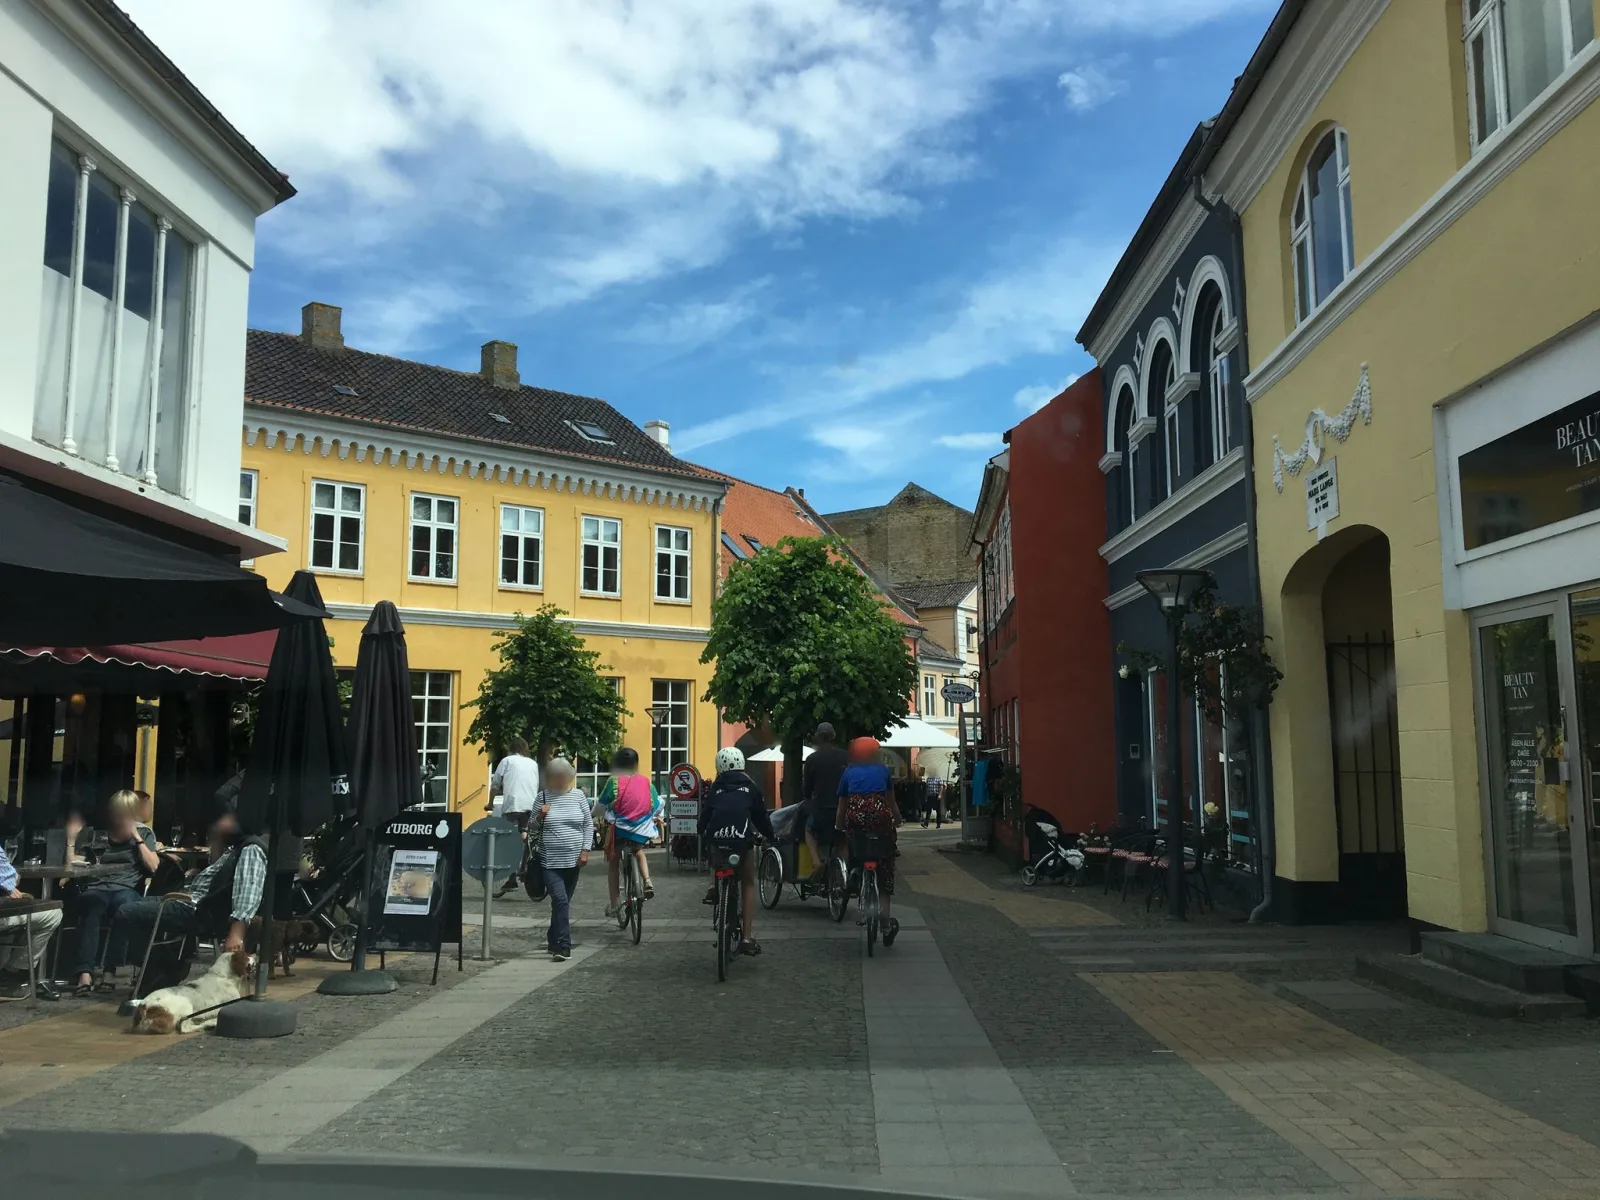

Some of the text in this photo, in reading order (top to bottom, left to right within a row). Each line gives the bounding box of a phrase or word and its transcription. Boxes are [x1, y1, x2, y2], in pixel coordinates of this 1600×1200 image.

[1556, 411, 1600, 451] BEAU
[1503, 672, 1536, 687] BEAUTY
[1512, 686, 1528, 699] TAN
